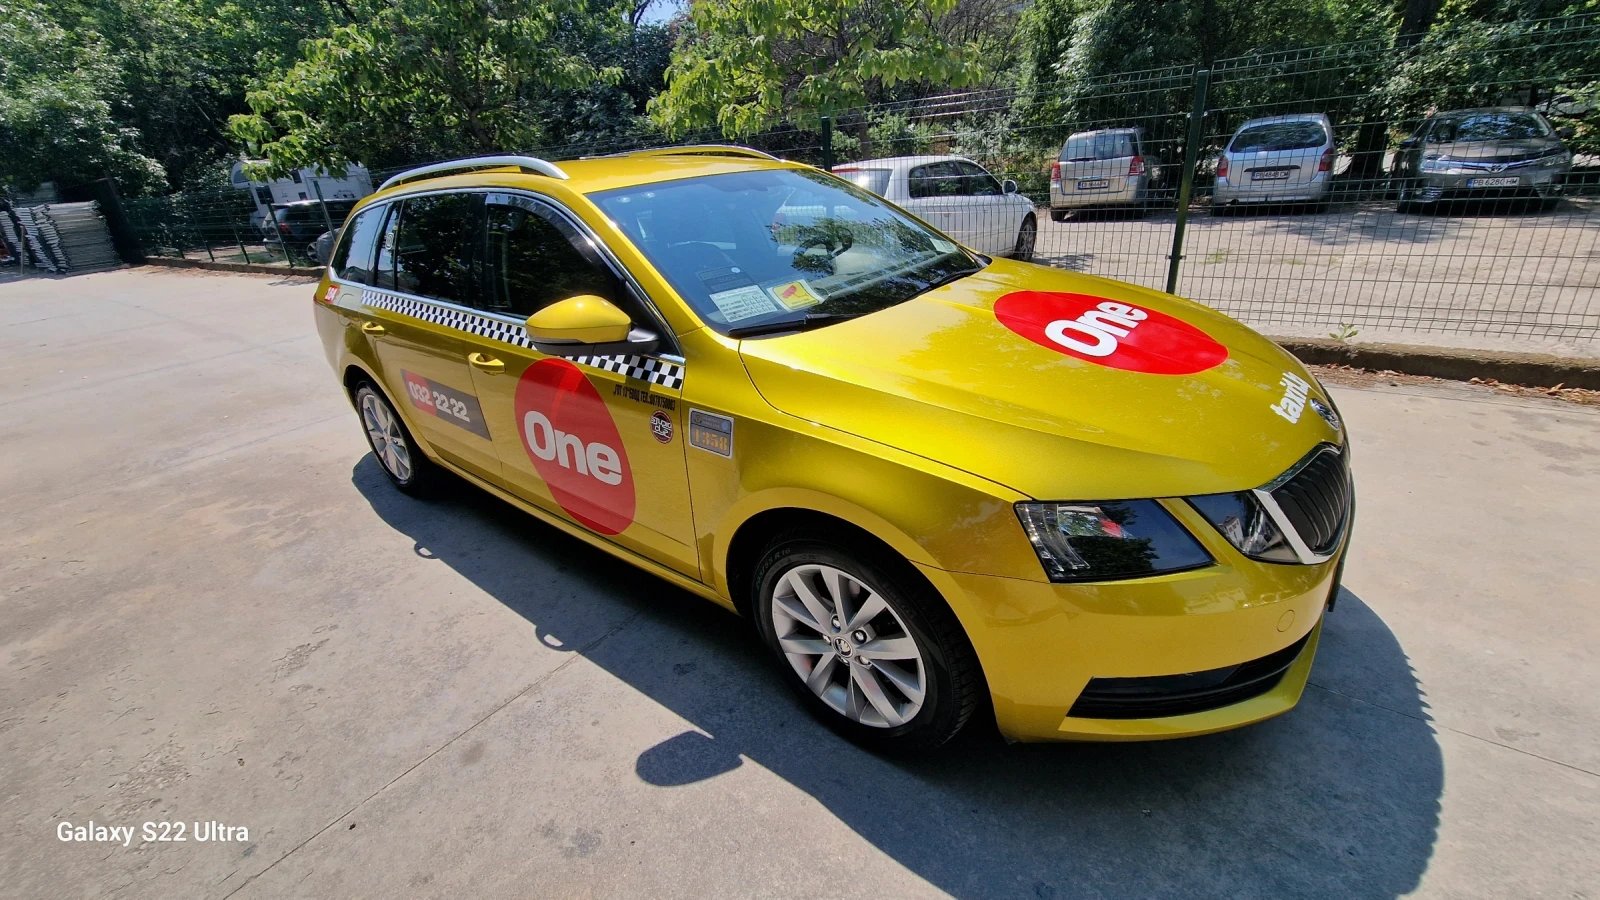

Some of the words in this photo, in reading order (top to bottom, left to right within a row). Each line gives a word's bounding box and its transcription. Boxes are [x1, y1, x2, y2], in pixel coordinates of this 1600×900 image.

[1044, 301, 1148, 357] One
[408, 381, 434, 406] 032
[433, 391, 452, 415] 22
[450, 400, 471, 423] 22
[524, 411, 622, 486] One
[694, 429, 728, 451] 1358
